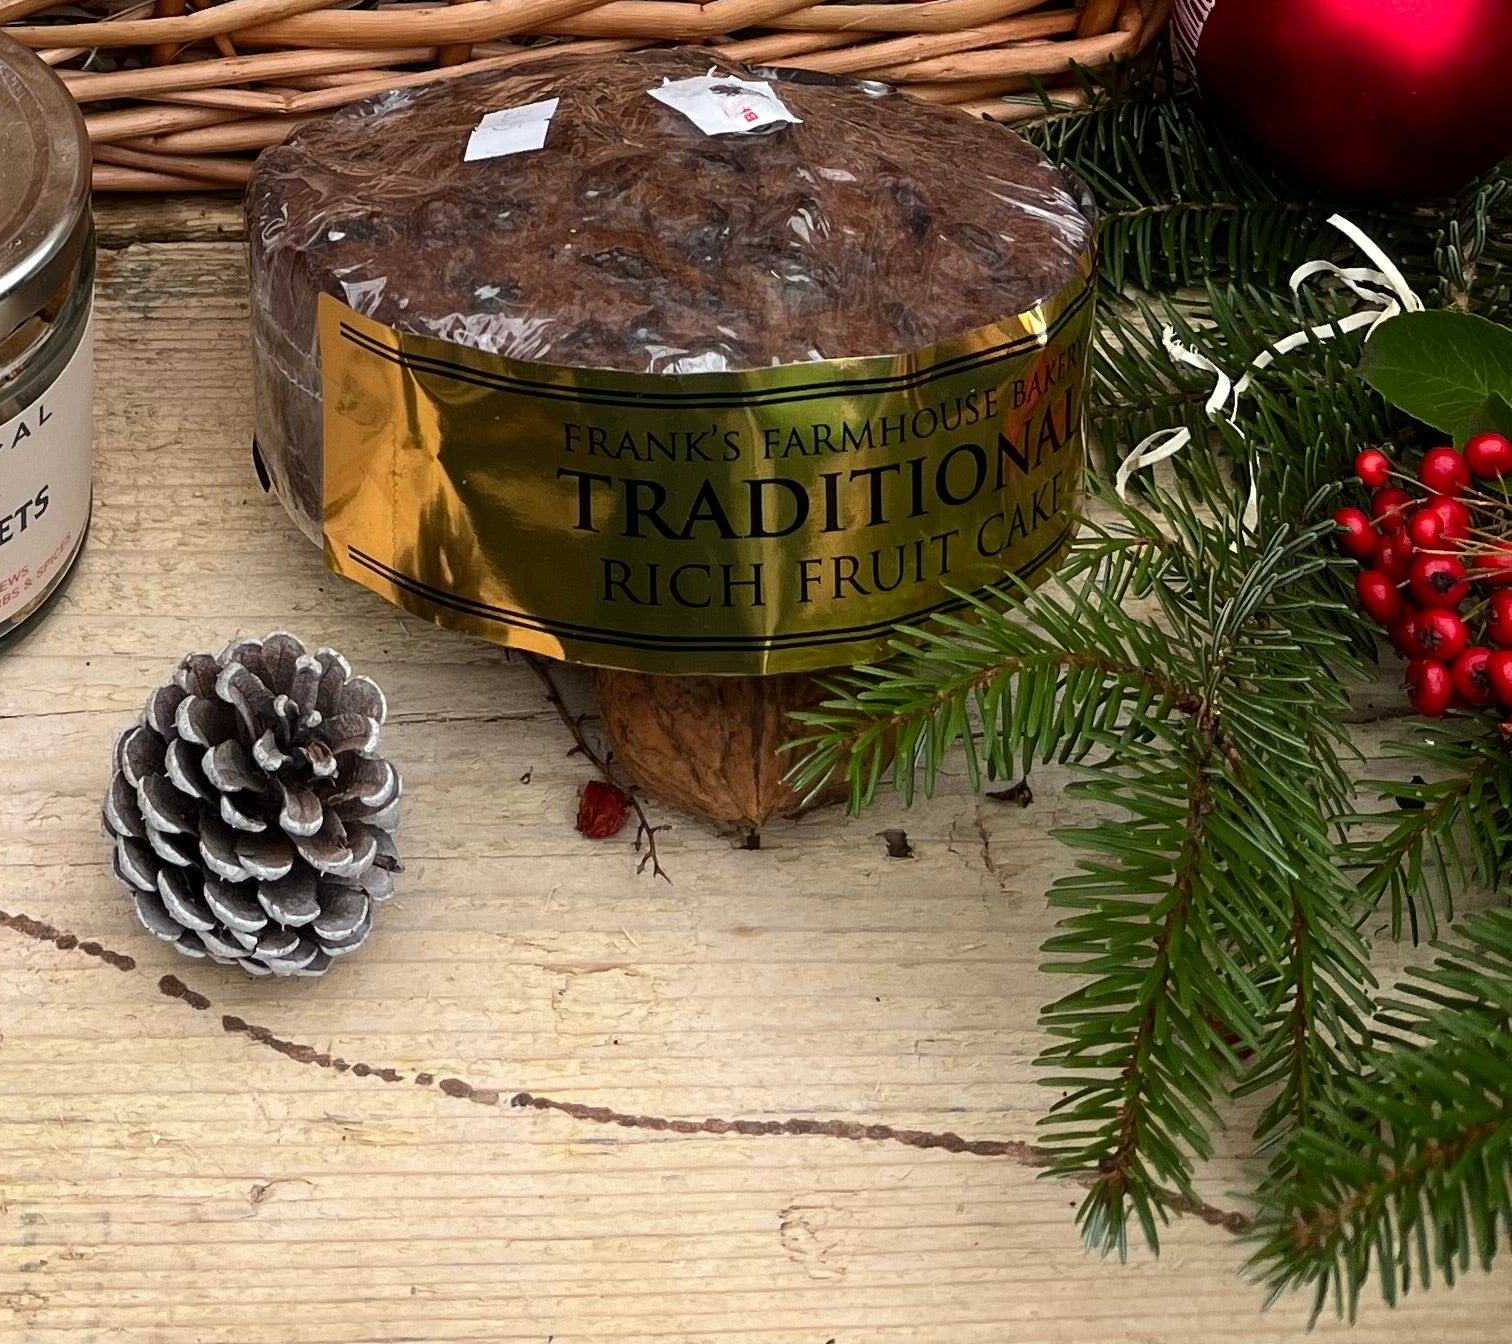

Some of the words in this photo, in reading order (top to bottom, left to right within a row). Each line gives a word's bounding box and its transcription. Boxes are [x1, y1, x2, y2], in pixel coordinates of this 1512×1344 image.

[555, 383, 1083, 541] TRADITIONAL
[562, 422, 742, 464] FRANK'S
[762, 386, 999, 461] FARMHOUSE
[1011, 334, 1085, 411] BAKERY
[35, 530, 72, 580] SPICES
[601, 555, 765, 608] RICH
[797, 531, 961, 603] FRUIT
[977, 471, 1064, 558] CAKE
